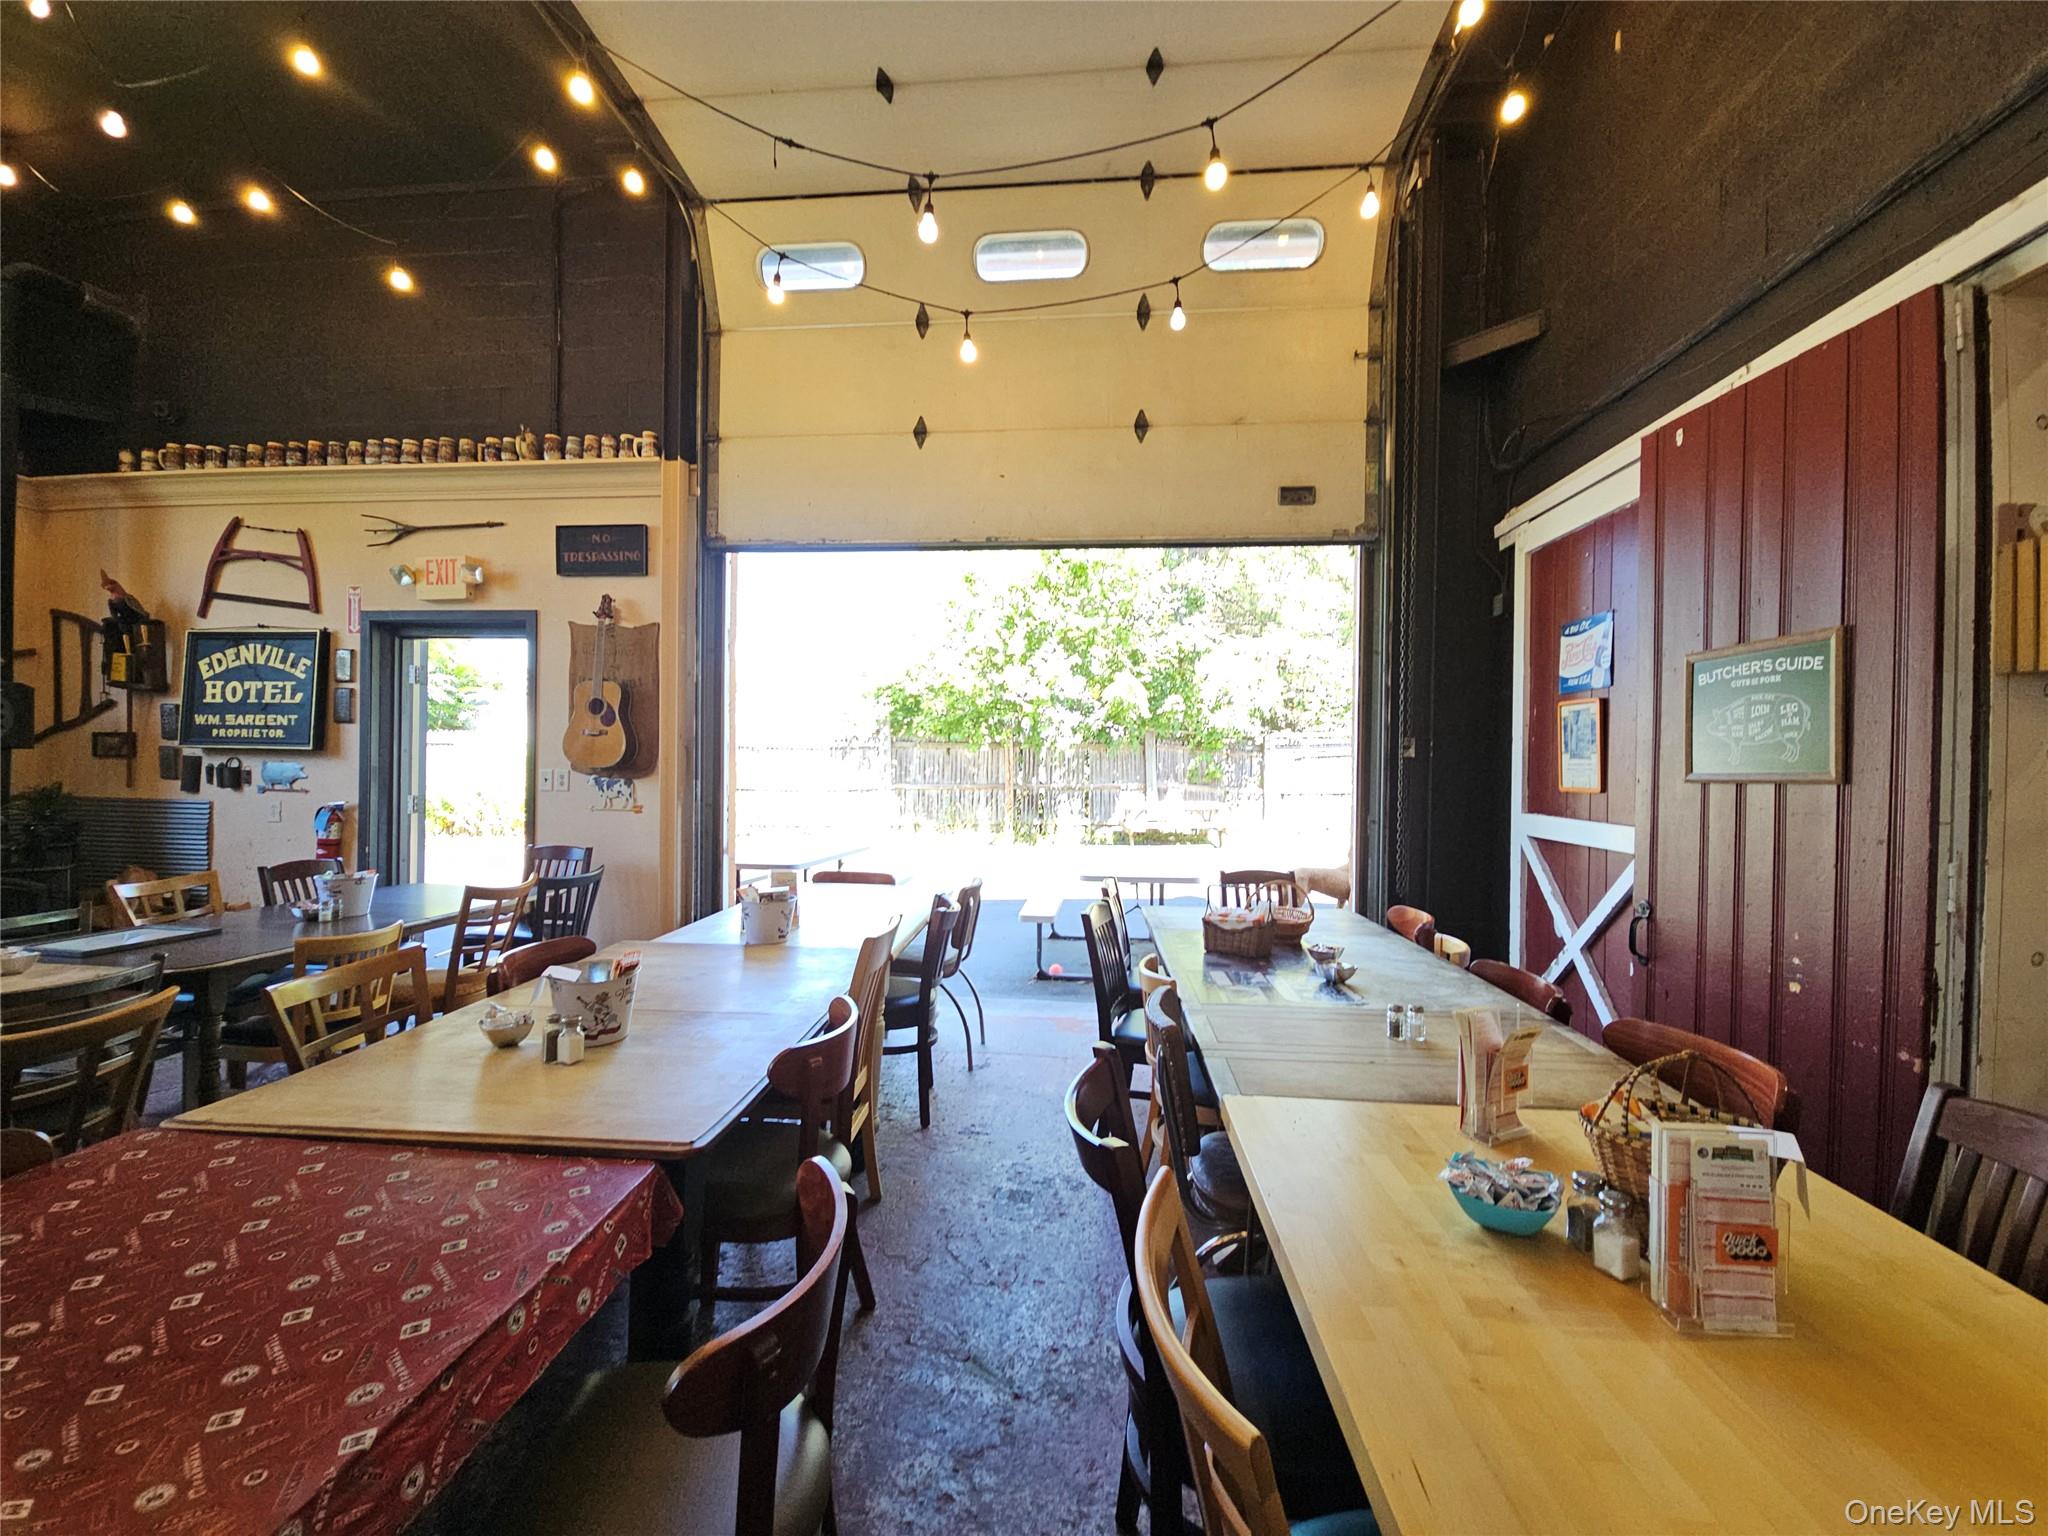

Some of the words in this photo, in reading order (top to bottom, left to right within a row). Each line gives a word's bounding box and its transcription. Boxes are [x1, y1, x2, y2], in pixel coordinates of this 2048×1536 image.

[591, 533, 611, 545] NO
[563, 551, 642, 563] TRESPASSING
[425, 558, 458, 586] EXIT
[197, 643, 312, 680] EDENVILLE
[1697, 658, 1774, 686] BUTCHER'S
[1775, 655, 1825, 671] GUIDE
[1730, 678, 1750, 689] CUTS
[1760, 673, 1782, 685] PORK
[202, 680, 304, 704] HOTEL
[225, 714, 299, 726] SARGENT
[1722, 1231, 1759, 1247] Quick
